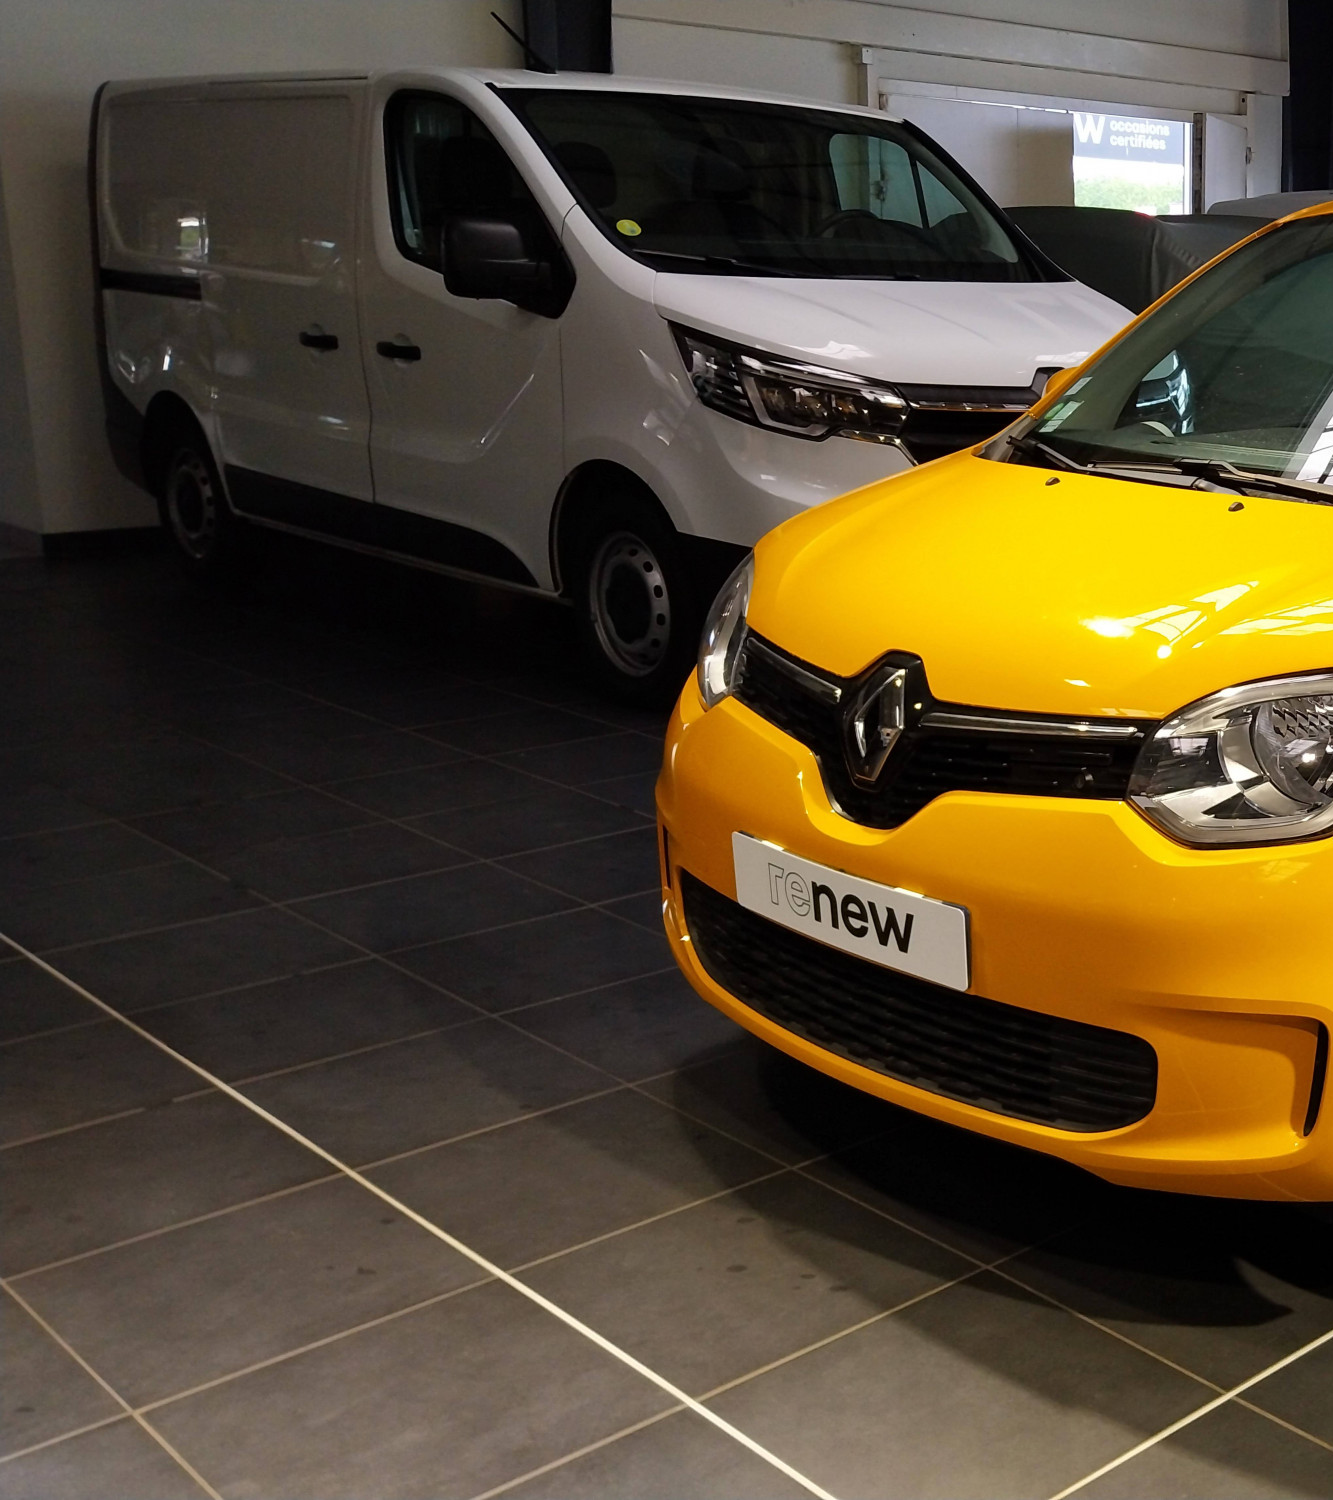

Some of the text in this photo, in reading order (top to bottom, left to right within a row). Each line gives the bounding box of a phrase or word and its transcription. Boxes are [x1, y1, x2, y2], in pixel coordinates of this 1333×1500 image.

[1109, 120, 1170, 136] occasions
[1109, 134, 1167, 150] certifiées
[767, 862, 914, 954] renew
